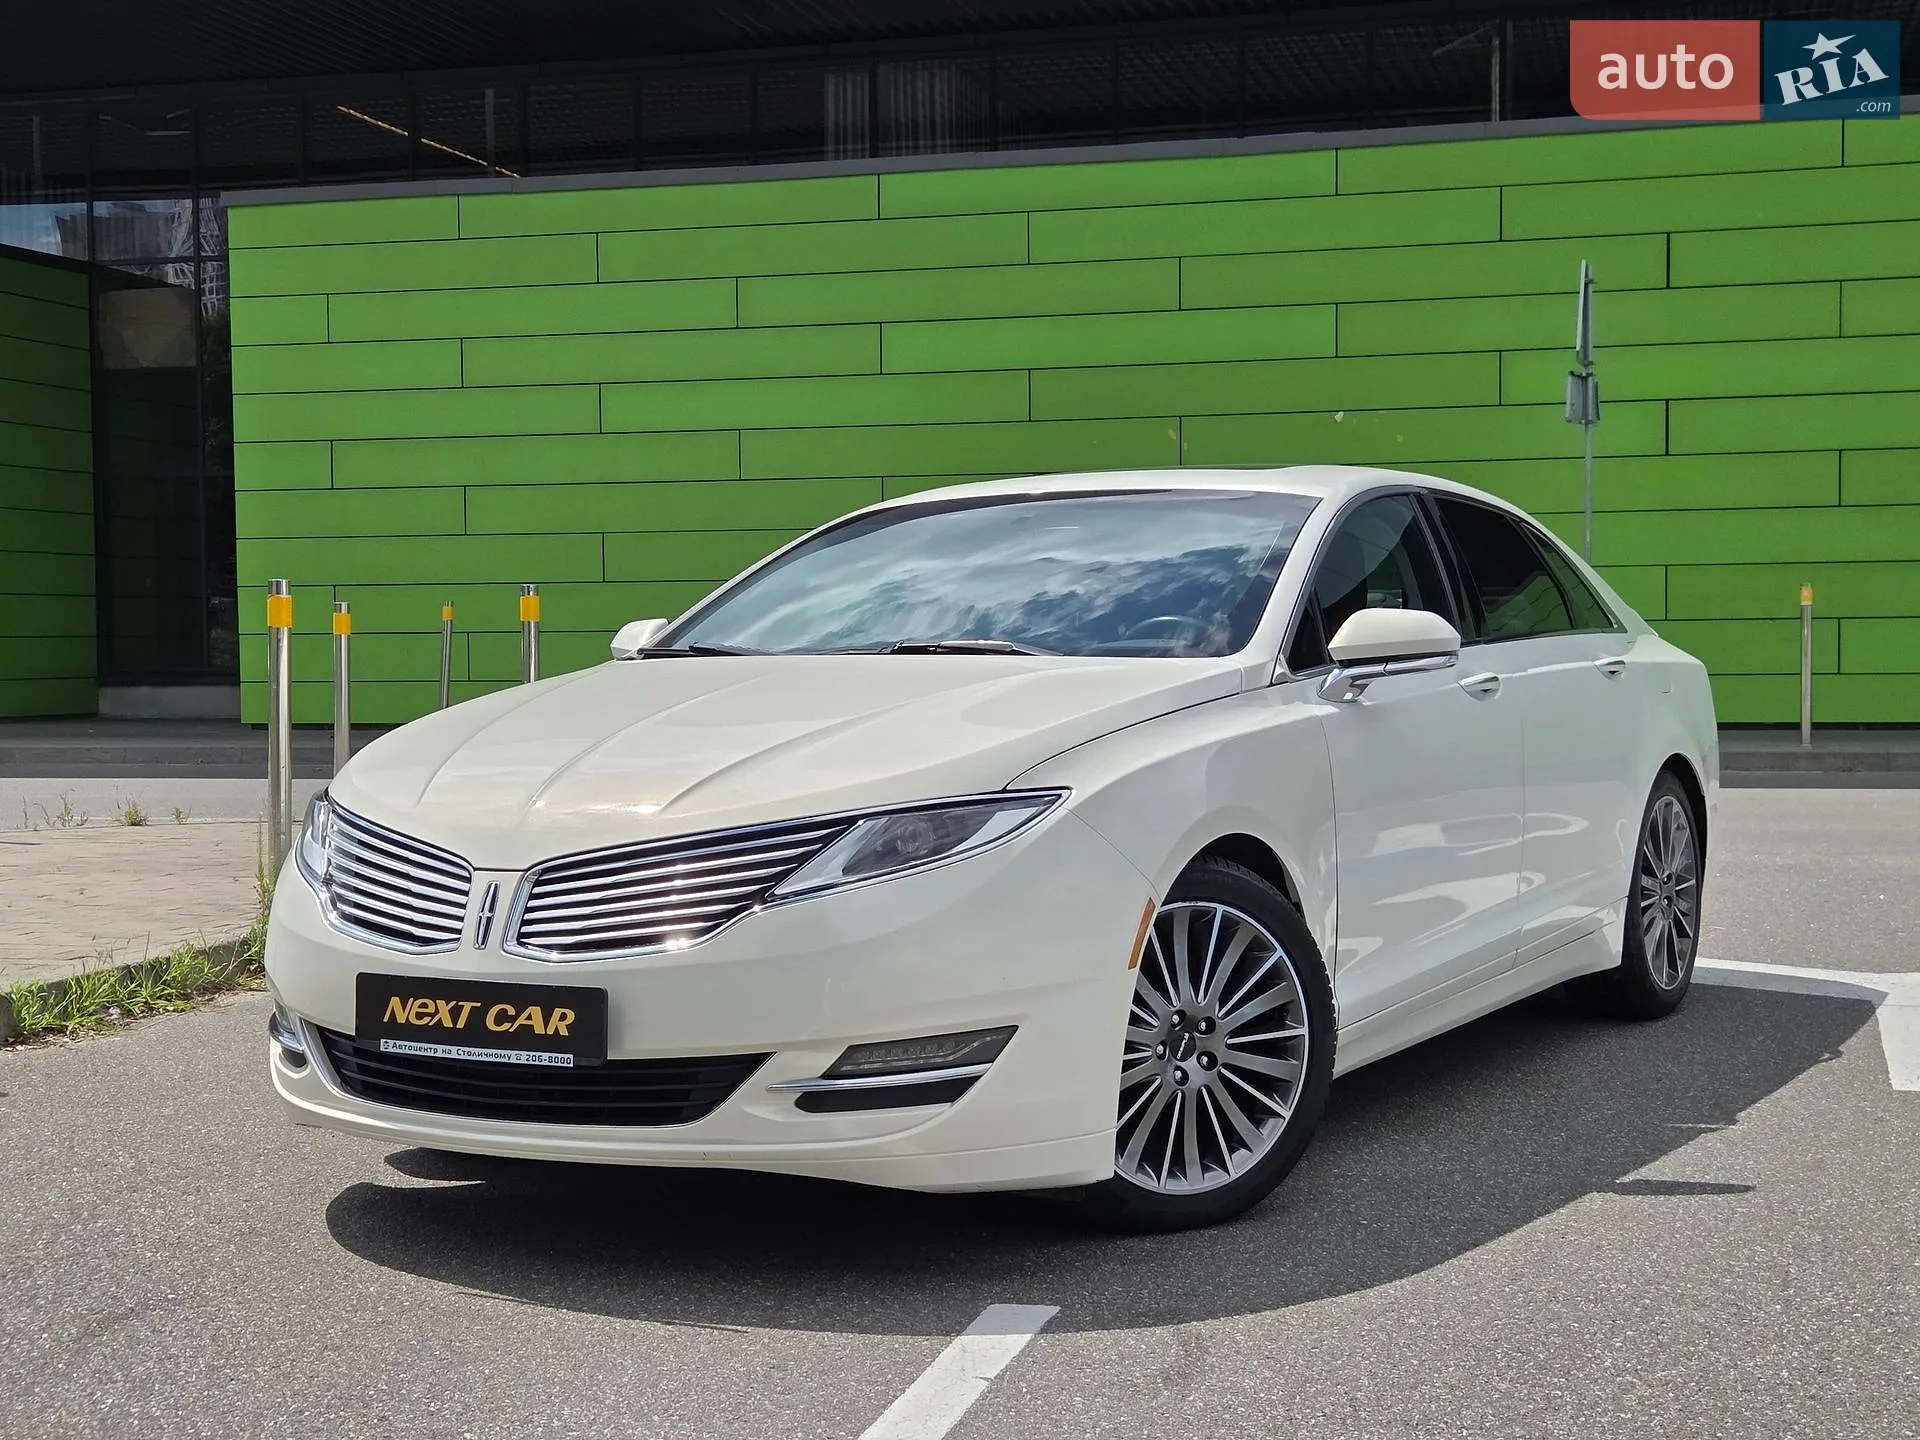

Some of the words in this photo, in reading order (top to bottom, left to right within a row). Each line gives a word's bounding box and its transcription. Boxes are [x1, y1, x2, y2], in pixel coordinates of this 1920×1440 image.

[485, 1003, 576, 1036] CAR
[391, 1042, 439, 1056] Автоцентр
[441, 1047, 452, 1056] на
[456, 1048, 512, 1061] Столичному
[525, 1054, 572, 1065] 206-8000
